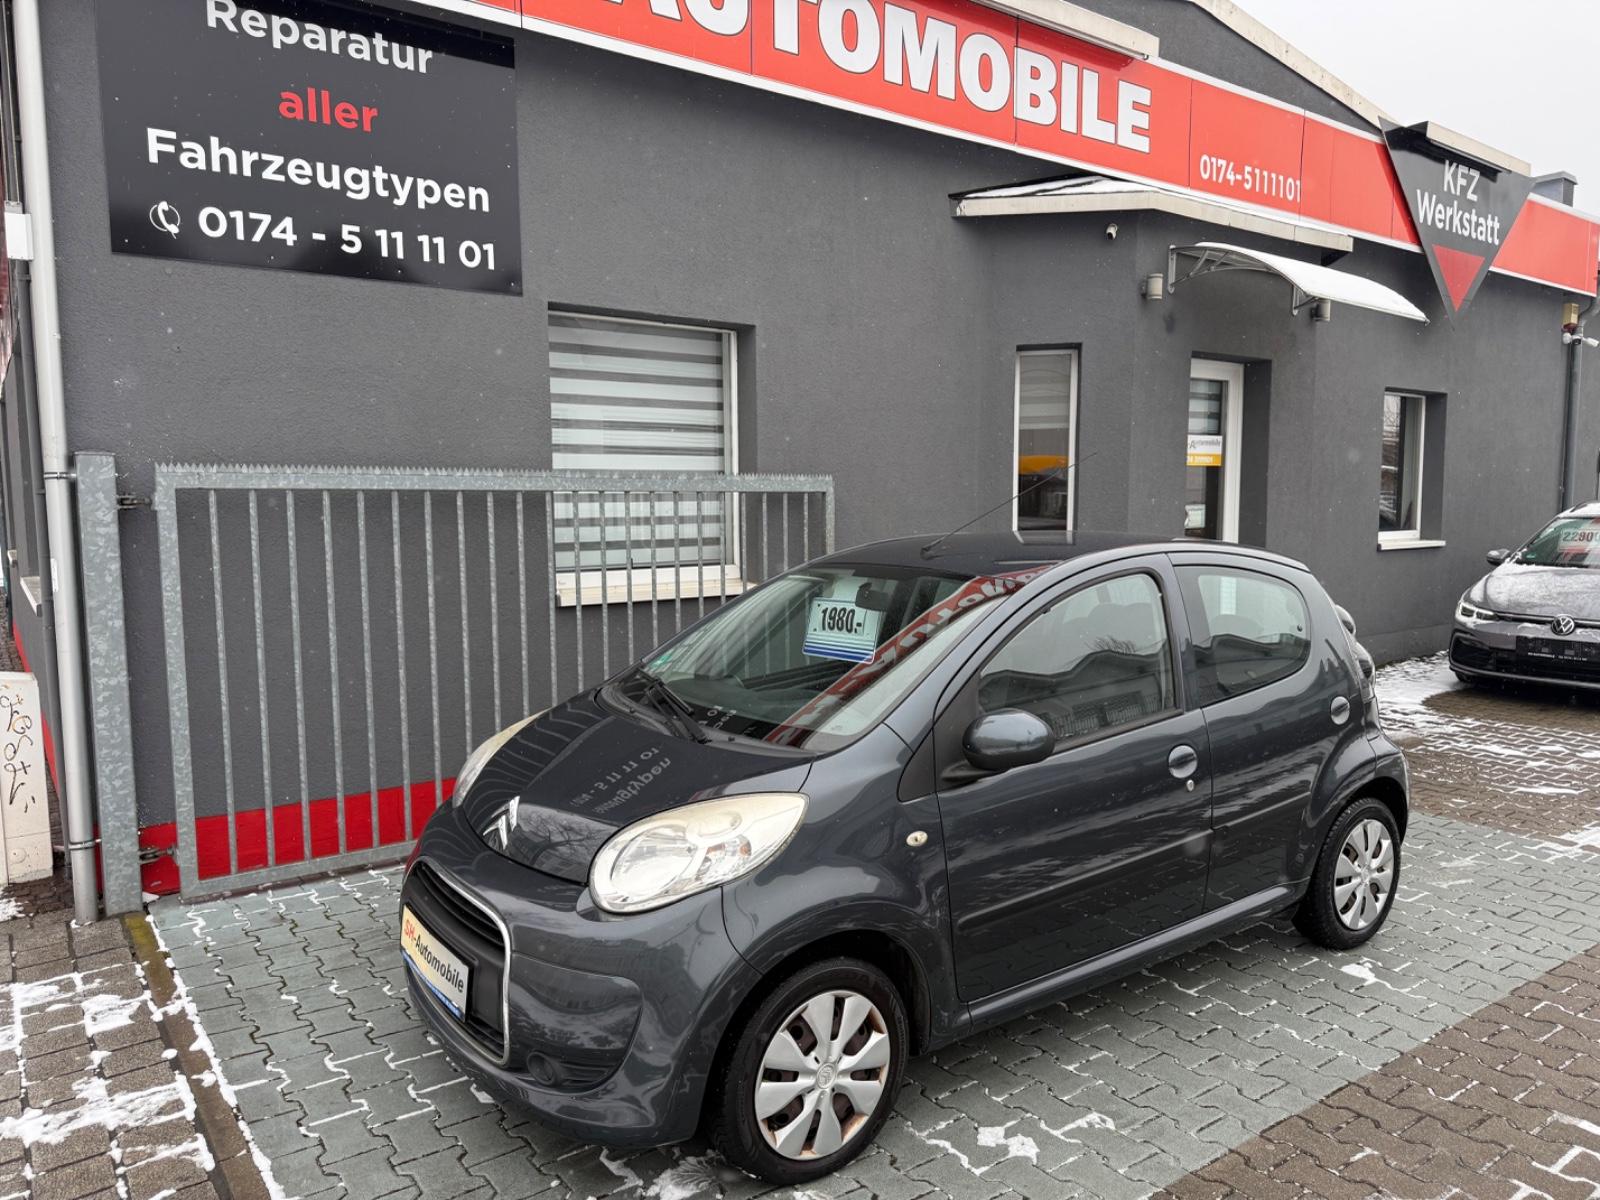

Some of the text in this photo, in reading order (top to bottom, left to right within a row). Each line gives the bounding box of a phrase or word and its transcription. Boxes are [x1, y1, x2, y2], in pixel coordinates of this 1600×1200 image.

[206, 0, 433, 74] Reparatur
[278, 87, 379, 133] aller
[146, 127, 490, 213] Fahrzeugtypen
[1200, 154, 1302, 203] 0174-5111101
[1443, 159, 1481, 202] KFZ
[198, 206, 298, 246] 0174
[340, 225, 363, 254] 5
[375, 229, 405, 260] 11
[417, 234, 447, 265] 11
[458, 240, 496, 271] 01
[1416, 188, 1500, 246] Werkstatt
